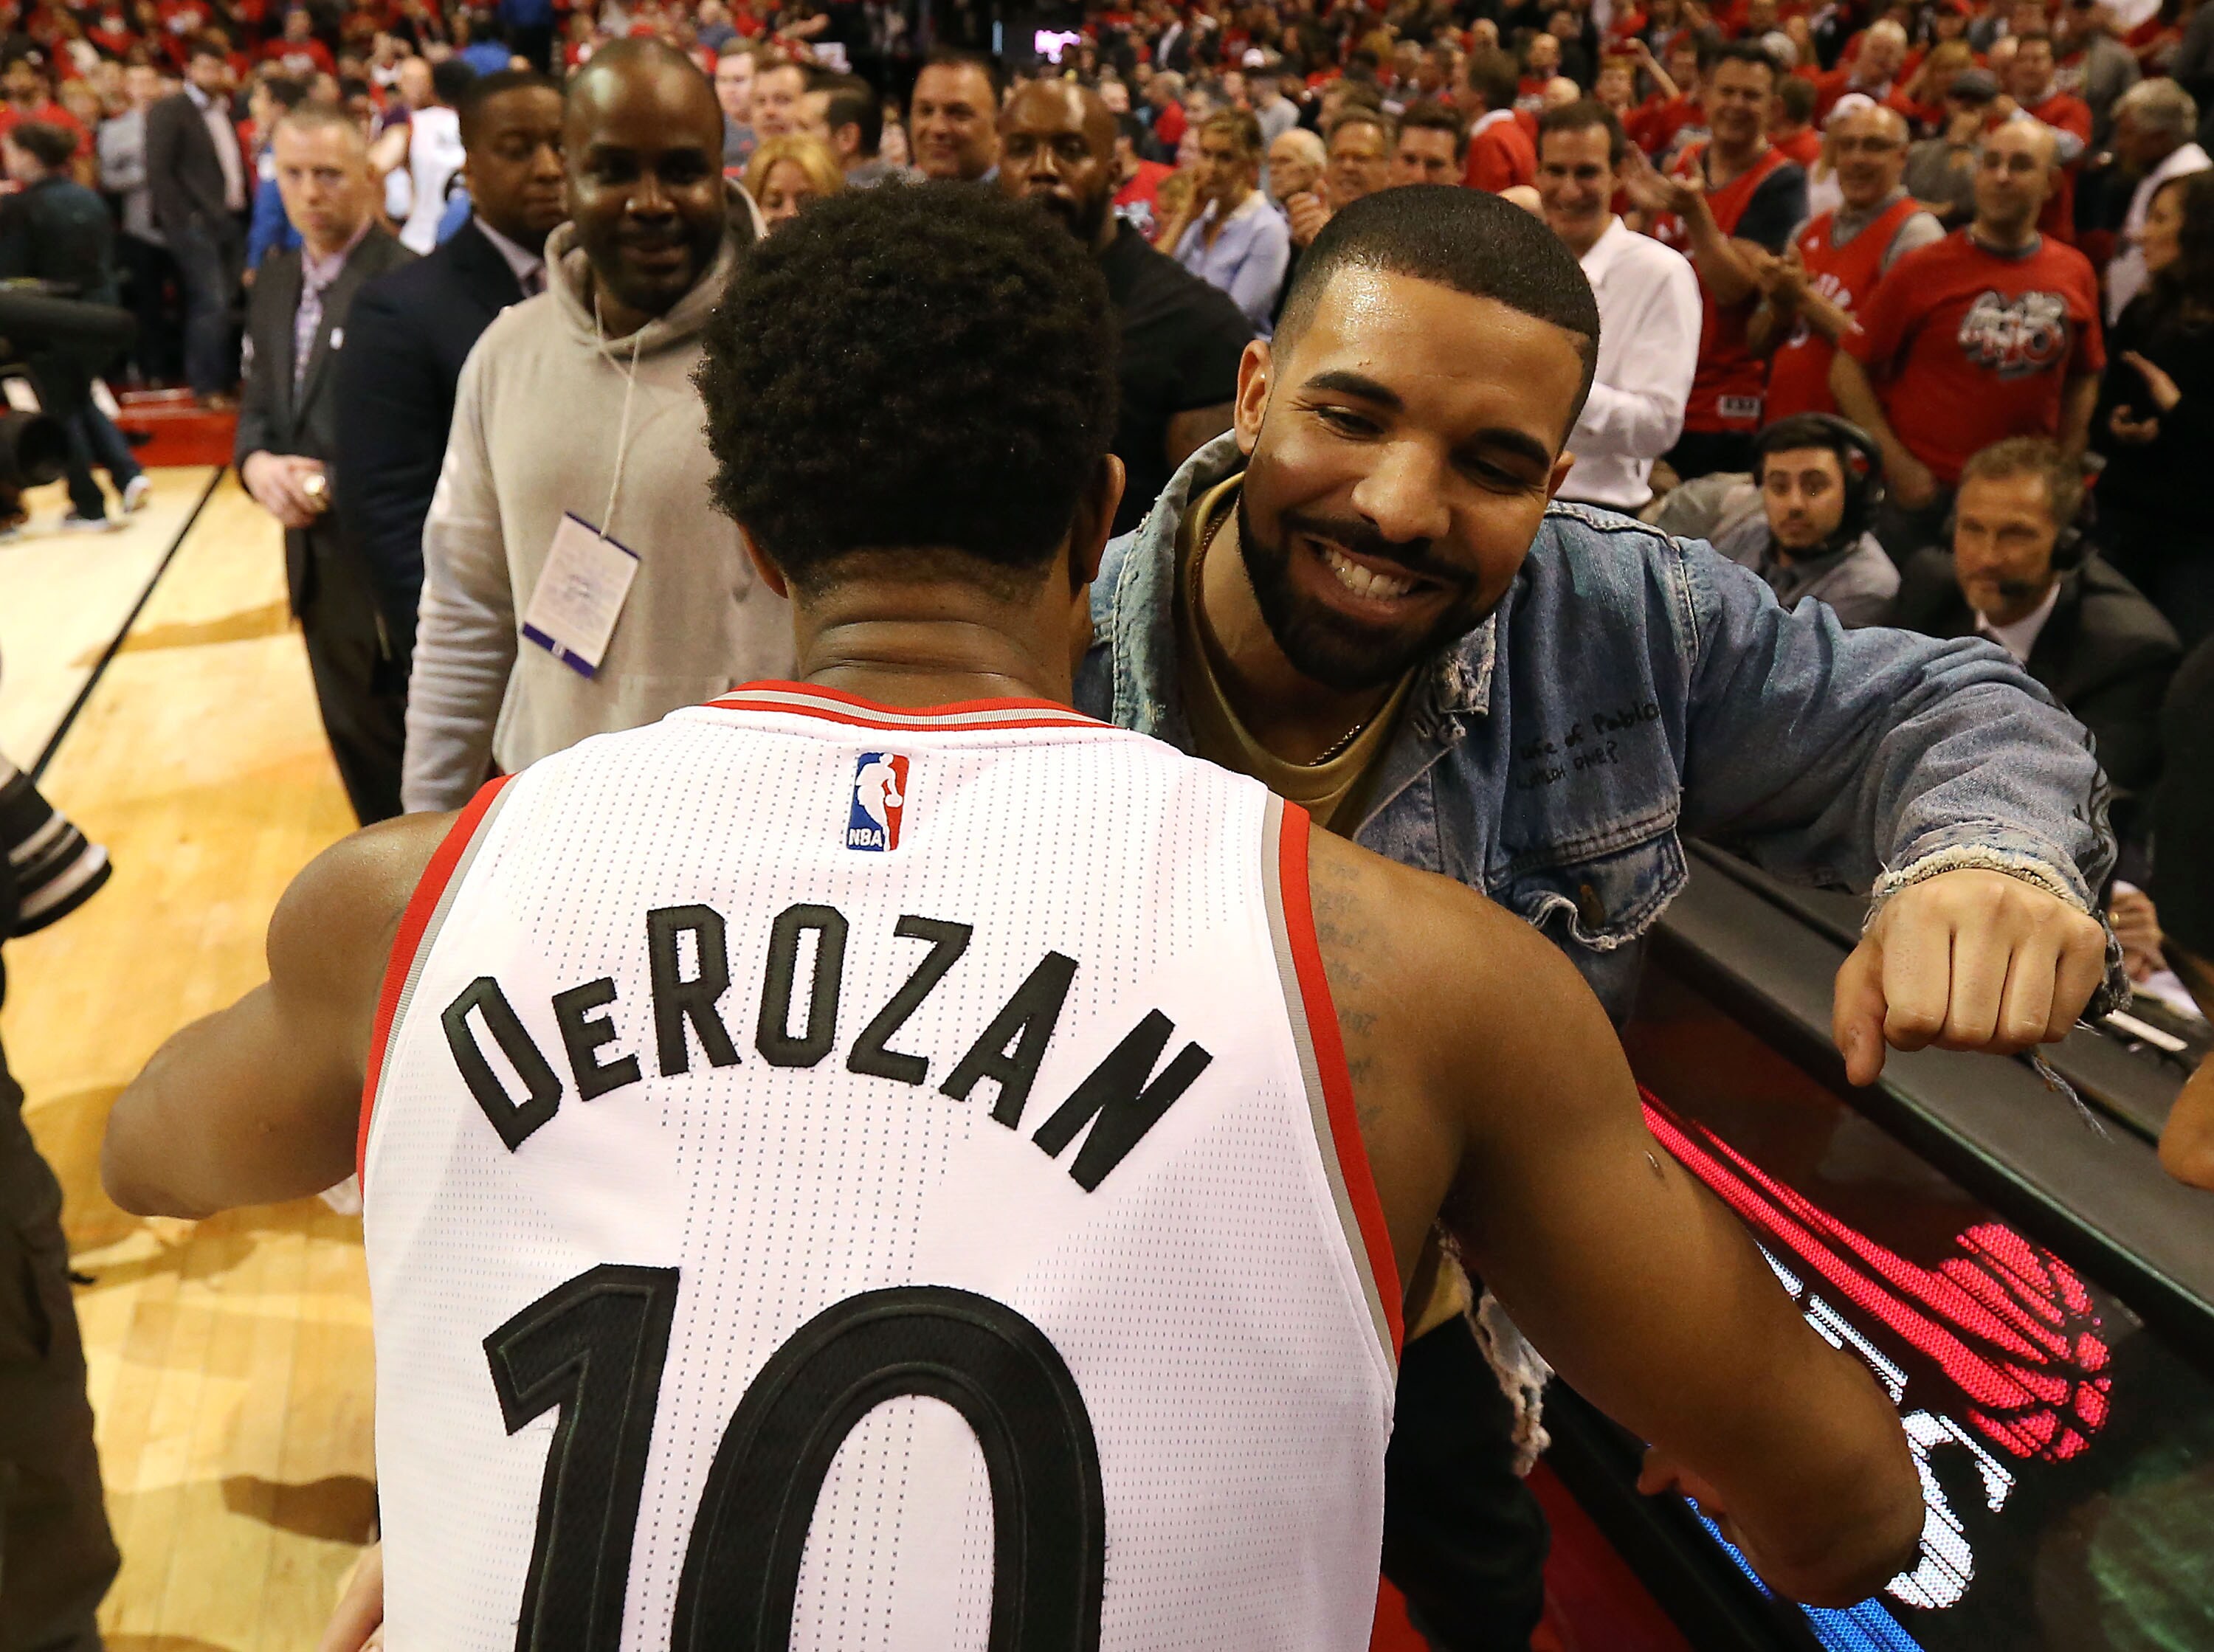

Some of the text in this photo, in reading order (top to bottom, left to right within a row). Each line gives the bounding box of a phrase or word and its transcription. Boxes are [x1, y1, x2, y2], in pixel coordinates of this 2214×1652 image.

[1565, 723, 1583, 748] of
[849, 829, 883, 847] NBA
[483, 1263, 1106, 1652] 10
